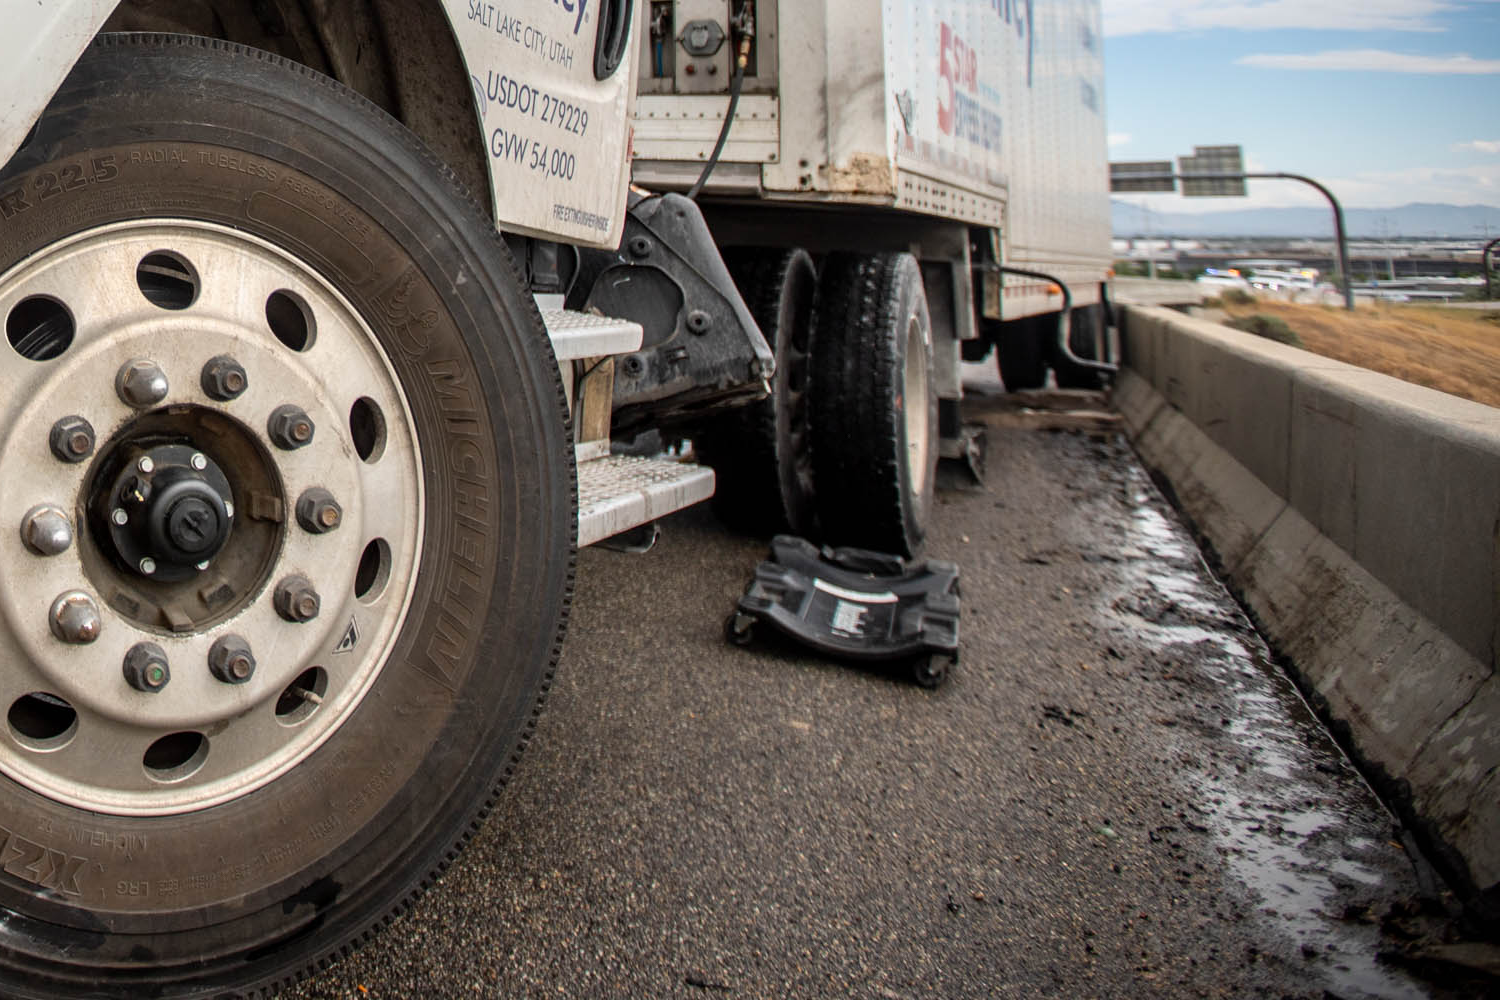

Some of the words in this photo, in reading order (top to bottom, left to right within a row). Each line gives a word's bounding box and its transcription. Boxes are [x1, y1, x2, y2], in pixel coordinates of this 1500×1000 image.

[496, 10, 522, 43] LAKE
[524, 26, 547, 60] CITY,
[549, 39, 574, 71] UTAH
[487, 70, 539, 117] USDOT
[540, 94, 589, 137] 279229
[938, 21, 955, 136] 5
[34, 153, 119, 202] 22.5
[130, 150, 189, 165] RADIAL
[196, 150, 277, 182] TUBELESS
[491, 128, 529, 164] GVW
[530, 142, 576, 181] 54,000
[427, 357, 491, 686] MICHELIN
